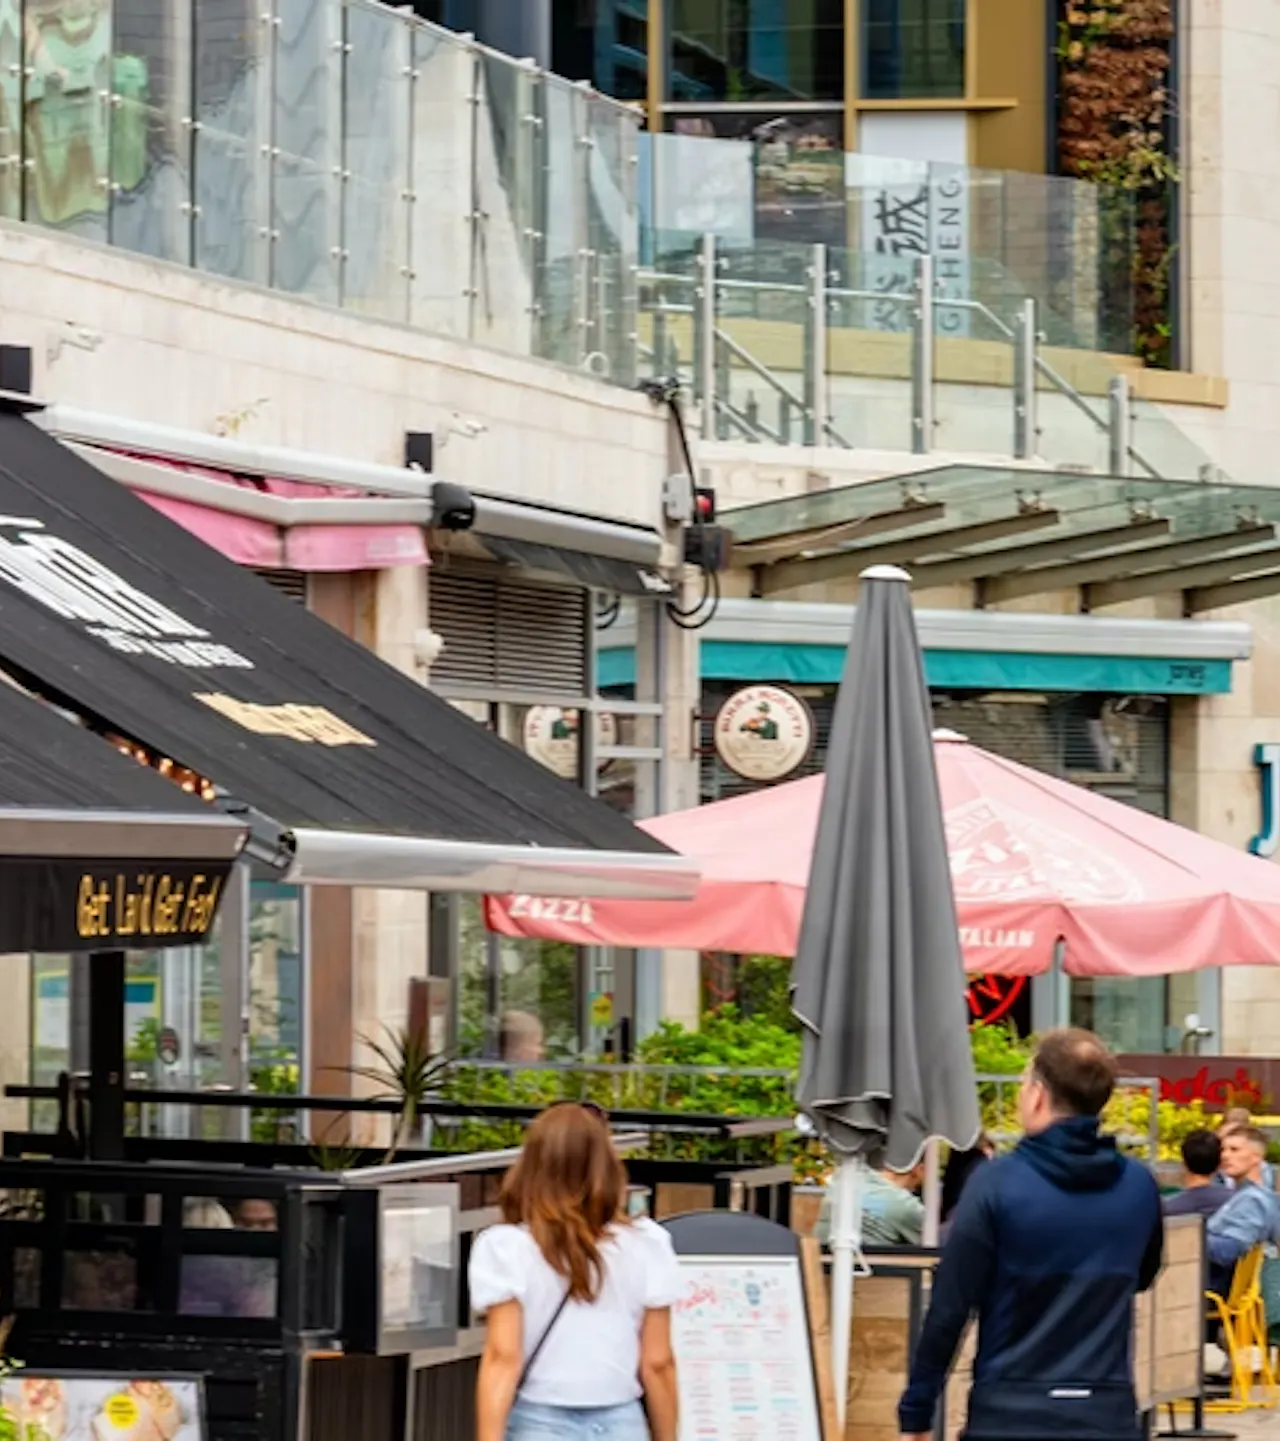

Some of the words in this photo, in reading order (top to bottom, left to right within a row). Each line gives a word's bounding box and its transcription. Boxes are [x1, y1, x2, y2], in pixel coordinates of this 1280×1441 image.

[76, 874, 111, 936] Get
[152, 873, 185, 934] Get
[508, 893, 594, 925] ZIZZI
[959, 928, 1037, 948] TALIAN
